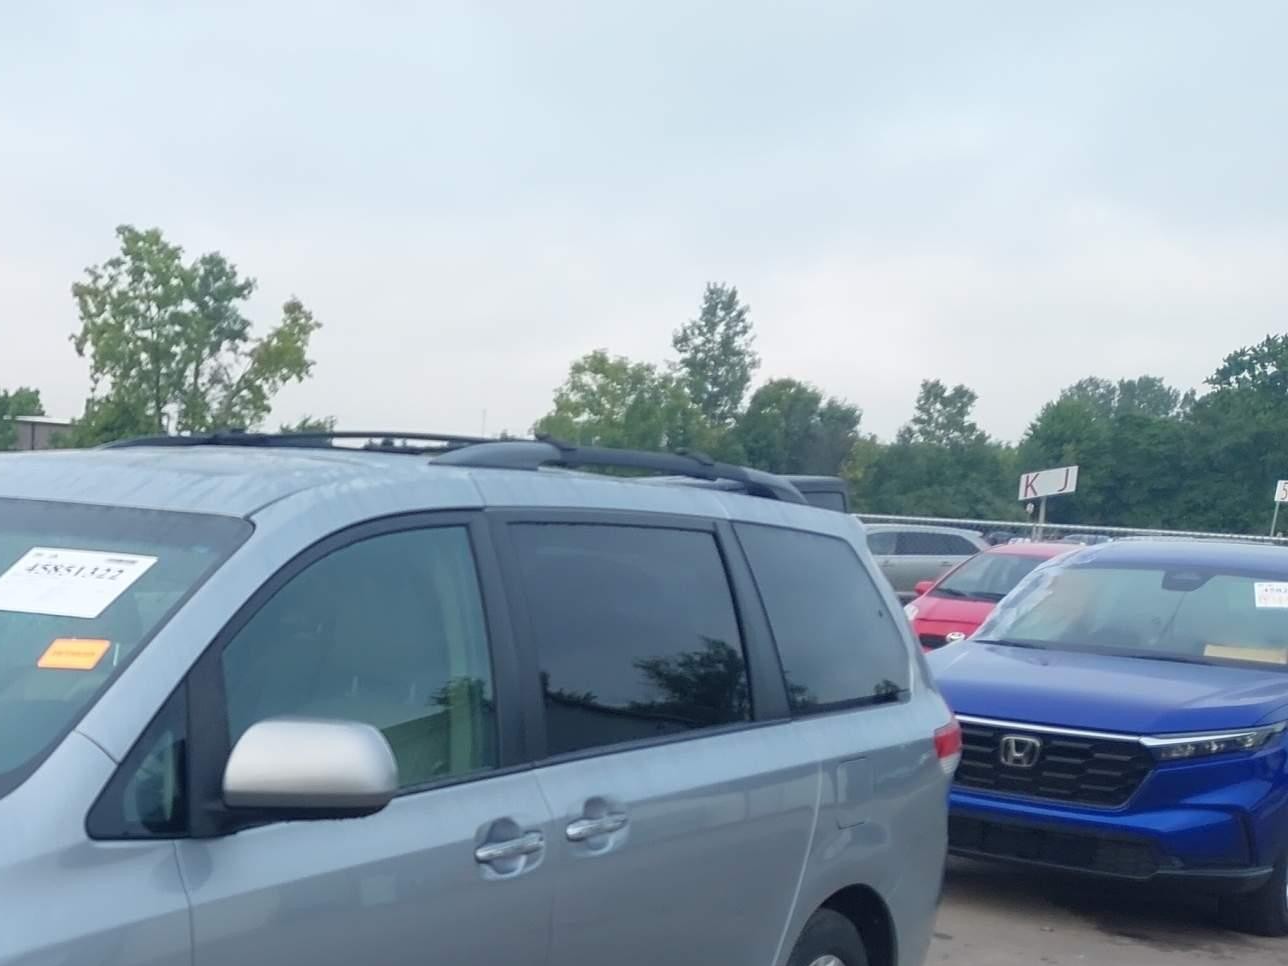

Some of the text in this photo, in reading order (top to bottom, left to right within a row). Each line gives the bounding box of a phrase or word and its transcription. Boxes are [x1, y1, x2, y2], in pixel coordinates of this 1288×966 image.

[1023, 468, 1070, 498] K J
[25, 563, 124, 580] 45851322
